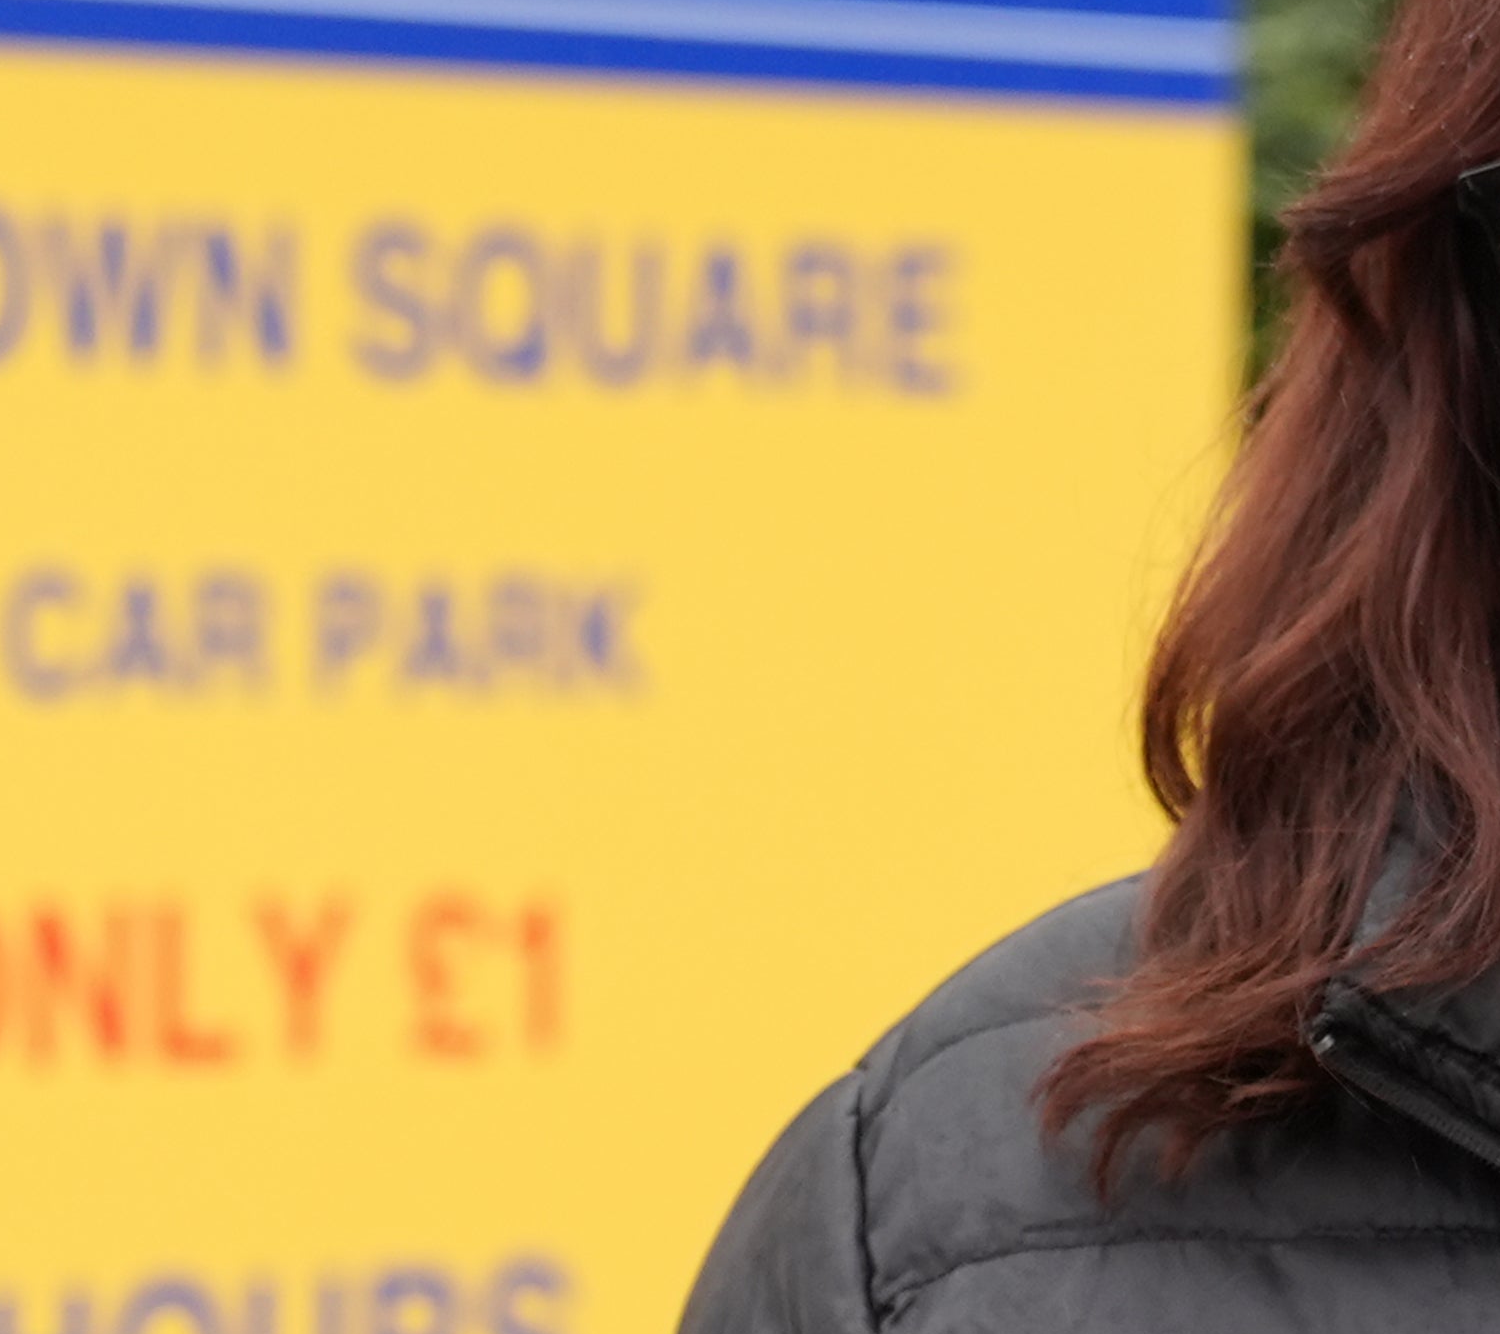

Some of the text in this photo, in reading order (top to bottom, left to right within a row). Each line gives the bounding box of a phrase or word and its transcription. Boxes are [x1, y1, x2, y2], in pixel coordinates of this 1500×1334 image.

[347, 215, 957, 401] SQUARE
[0, 567, 270, 703] CAR
[311, 568, 640, 695] PARK
[403, 888, 564, 1065] £1
